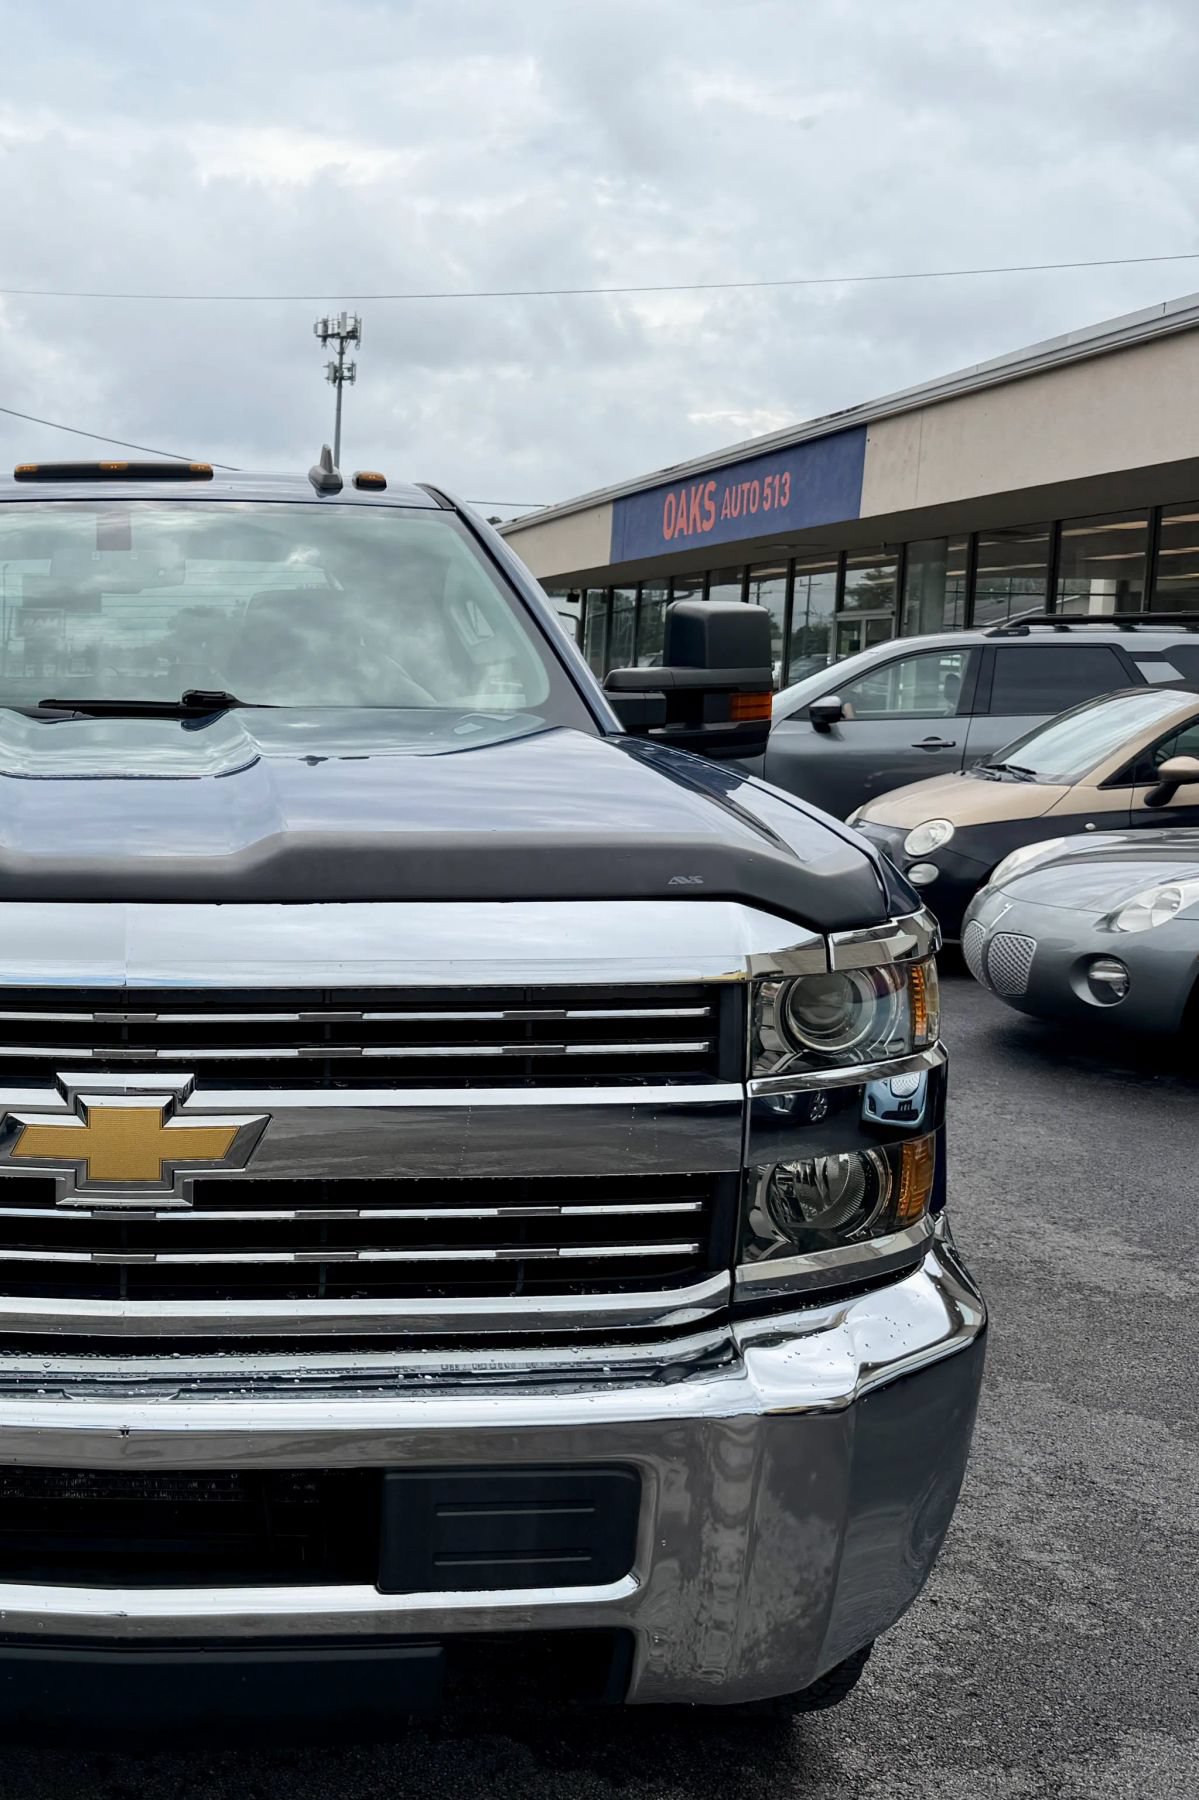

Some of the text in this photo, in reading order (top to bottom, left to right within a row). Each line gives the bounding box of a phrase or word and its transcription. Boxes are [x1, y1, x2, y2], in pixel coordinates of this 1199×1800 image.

[663, 472, 791, 540] OAKS AUTO 513
